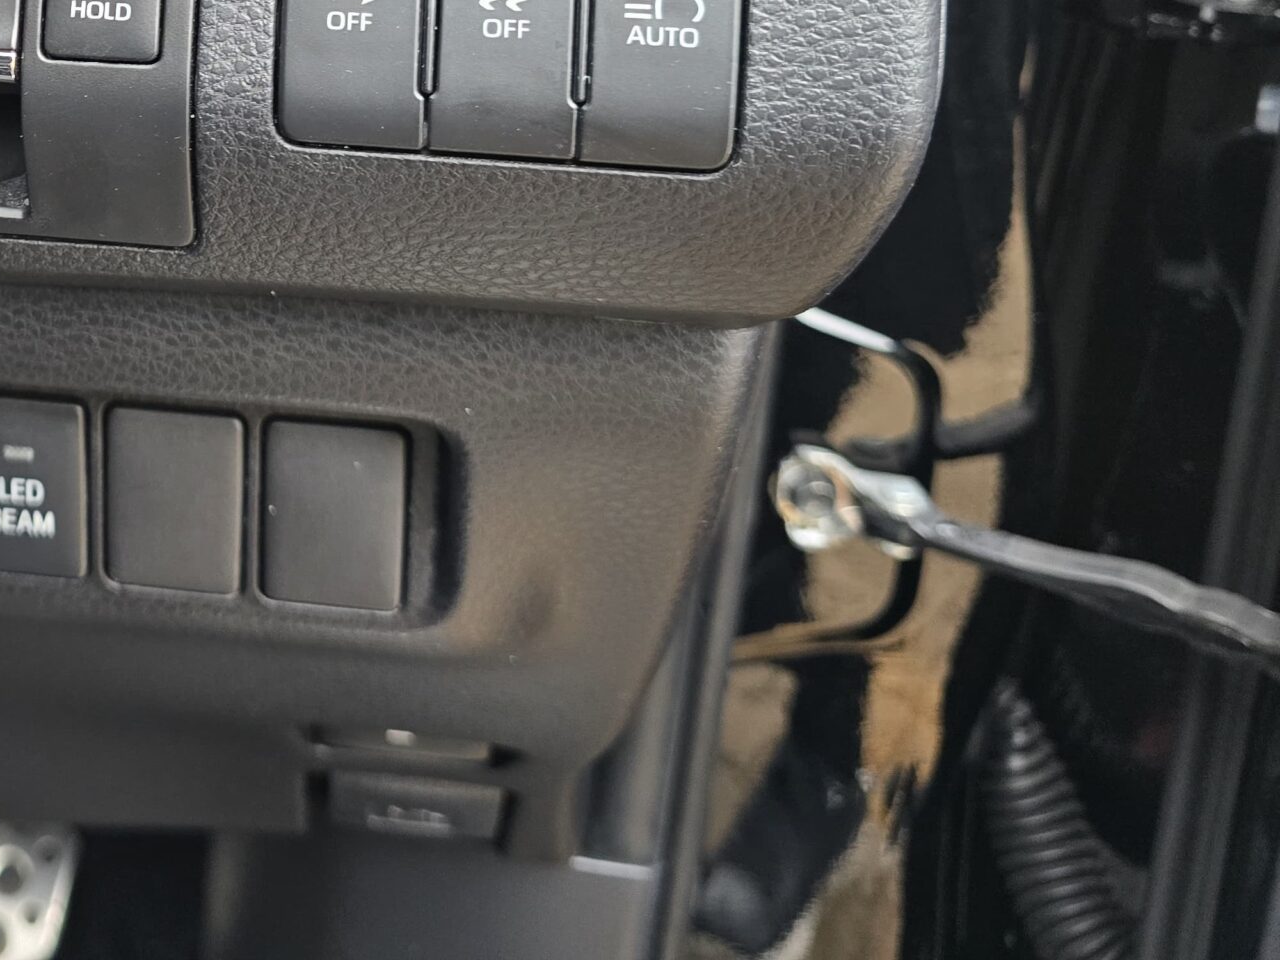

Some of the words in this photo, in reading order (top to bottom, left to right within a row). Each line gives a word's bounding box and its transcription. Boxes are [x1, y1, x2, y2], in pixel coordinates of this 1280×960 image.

[70, 0, 132, 21] HOLD
[326, 10, 373, 32] OFF
[482, 18, 531, 39] OFF
[626, 24, 700, 48] AUTO
